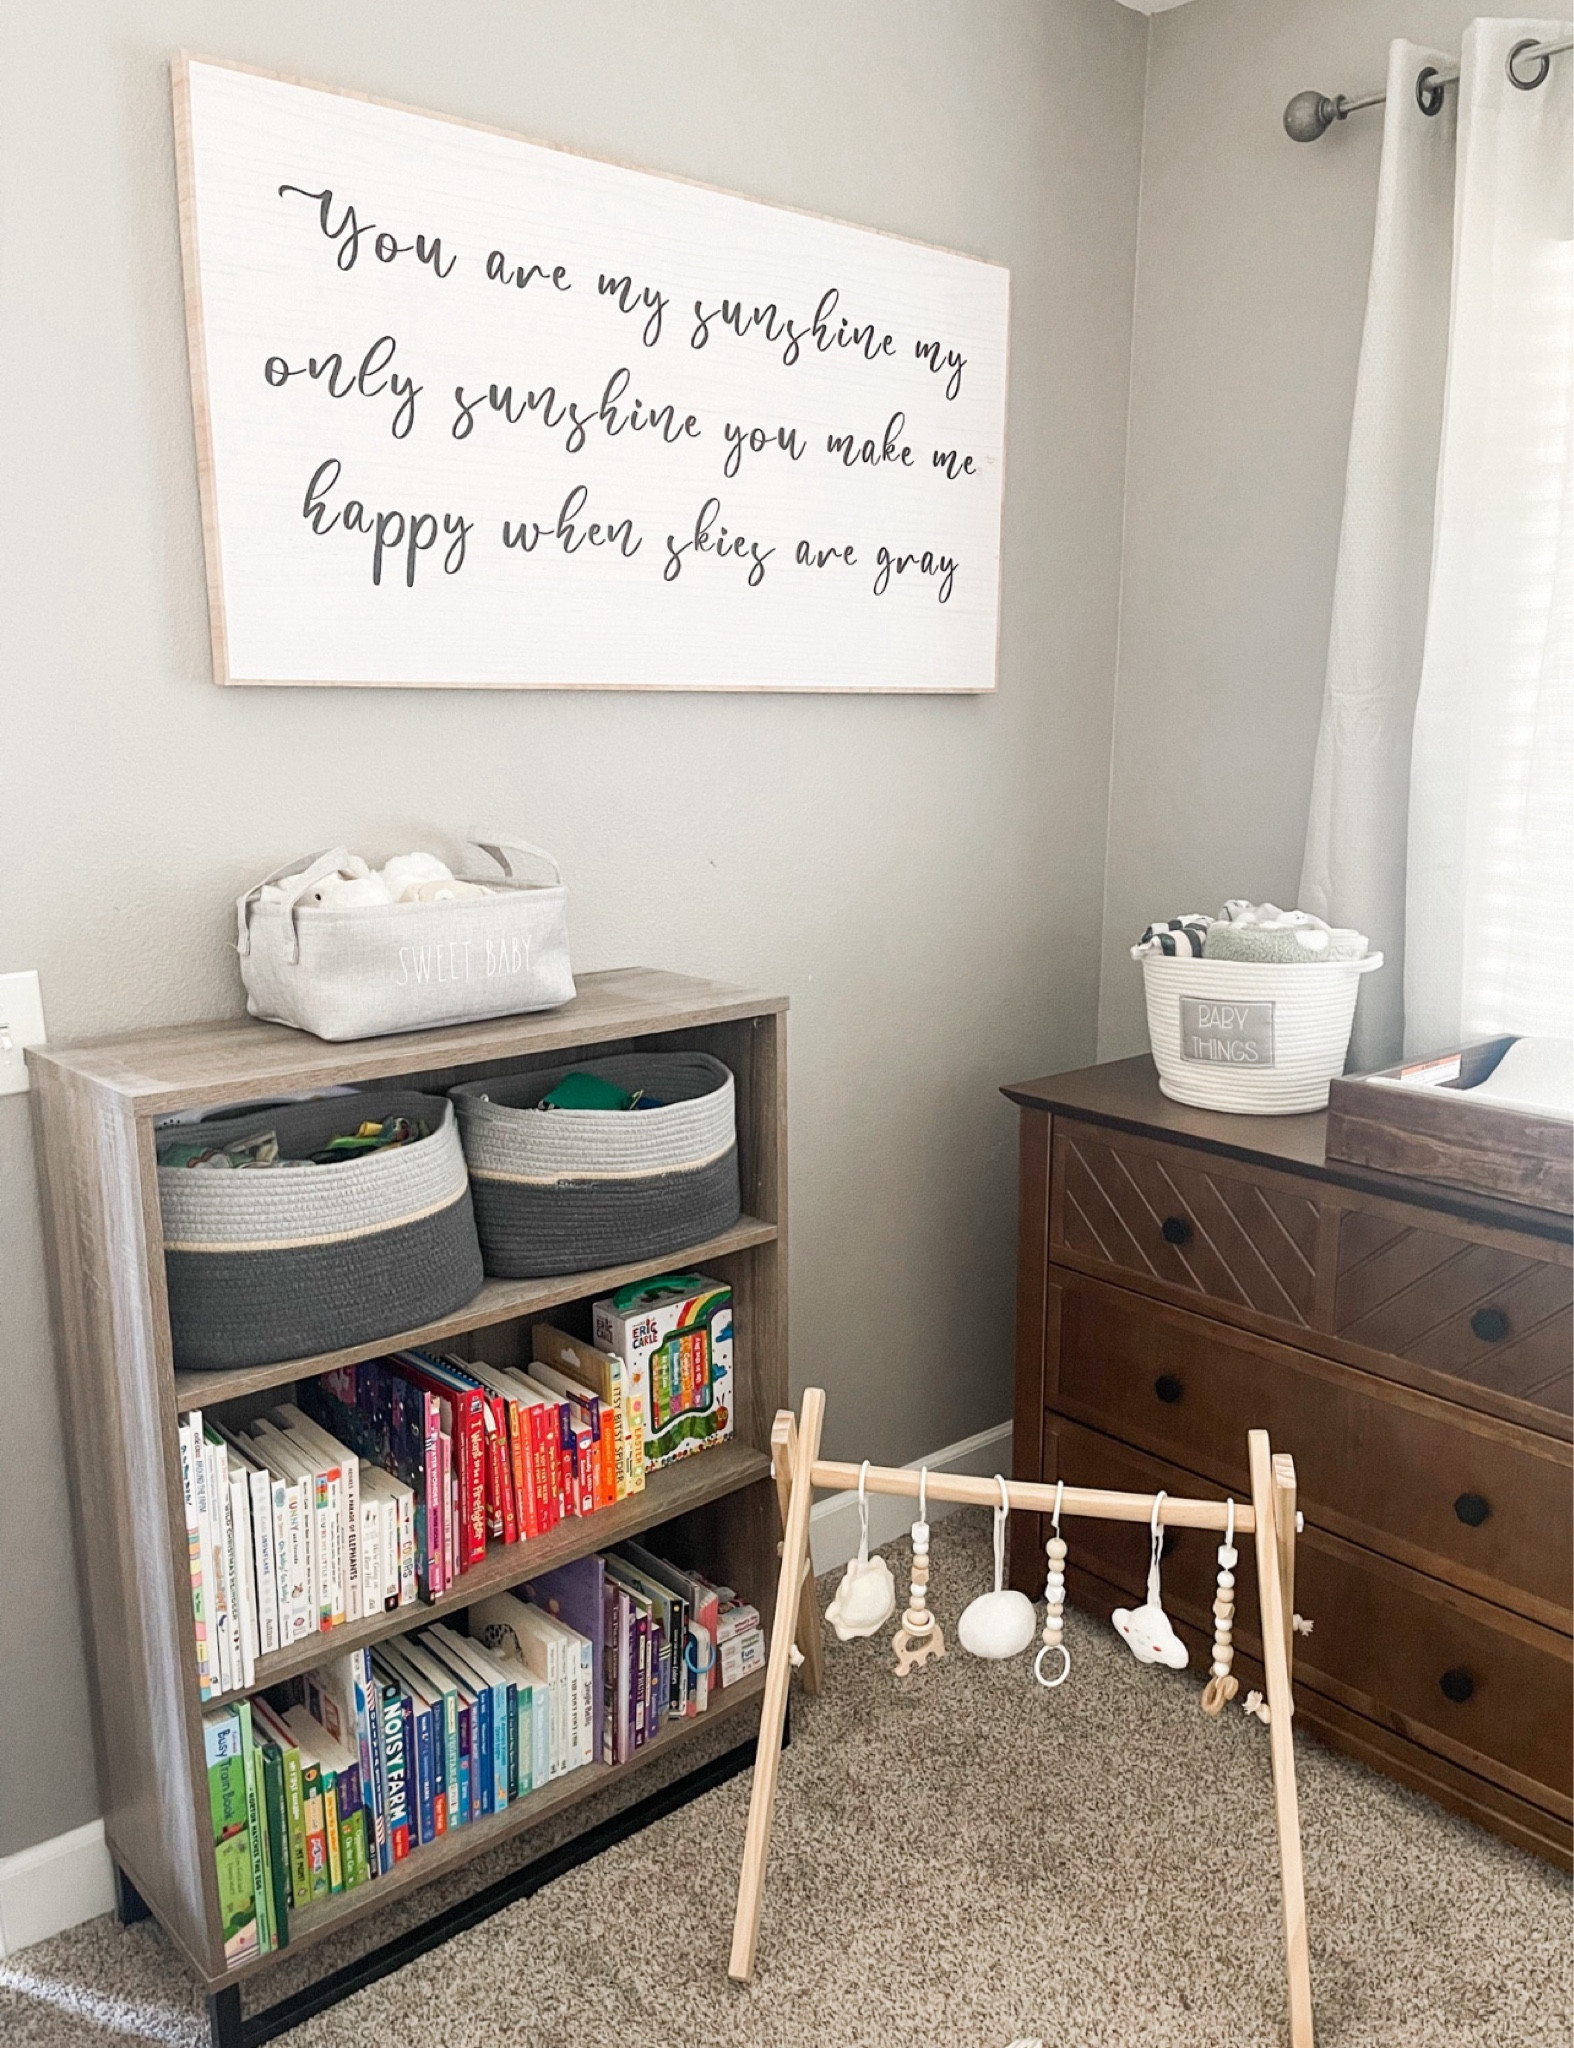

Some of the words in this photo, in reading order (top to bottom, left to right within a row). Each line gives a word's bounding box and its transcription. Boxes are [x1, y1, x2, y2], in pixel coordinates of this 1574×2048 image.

[279, 185, 456, 278] You
[487, 251, 571, 290] are
[598, 274, 669, 347] my
[691, 288, 896, 365] sunshine
[916, 341, 967, 400] my
[265, 336, 423, 439] only
[452, 368, 701, 452] sunshine
[724, 424, 806, 478] you
[828, 412, 914, 466] make
[933, 451, 976, 479] me
[303, 459, 473, 587] happy
[503, 485, 642, 557] when
[664, 498, 775, 586] skies
[797, 541, 857, 568] are
[874, 547, 958, 603] gray
[397, 941, 471, 985] SWEET
[486, 935, 532, 977] BABY
[1198, 1004, 1249, 1031] BABY
[1192, 1035, 1259, 1062] THINGS
[632, 1318, 658, 1338] ERIC
[632, 1333, 658, 1349] CARLE
[613, 1386, 622, 1410] ITSY
[471, 1420, 481, 1428] I
[615, 1413, 624, 1442] BITSY
[471, 1429, 481, 1460] Want
[634, 1427, 642, 1465] EASTER
[615, 1445, 624, 1484] SPIDER
[431, 1470, 439, 1507] WONDERS
[470, 1485, 484, 1540] Firefighter
[348, 1533, 358, 1581] ELEPHANTS
[402, 1540, 413, 1578] COLORS
[215, 1729, 230, 1757] Busy
[383, 1702, 403, 1768] NOISY
[218, 1759, 232, 1791] Train
[223, 1792, 236, 1820] Book
[248, 1792, 257, 1824] HORTON
[388, 1767, 406, 1823] FARM
[249, 1825, 260, 1859] HATCHES
[252, 1860, 261, 1874] THE
[254, 1875, 262, 1891] EGG
